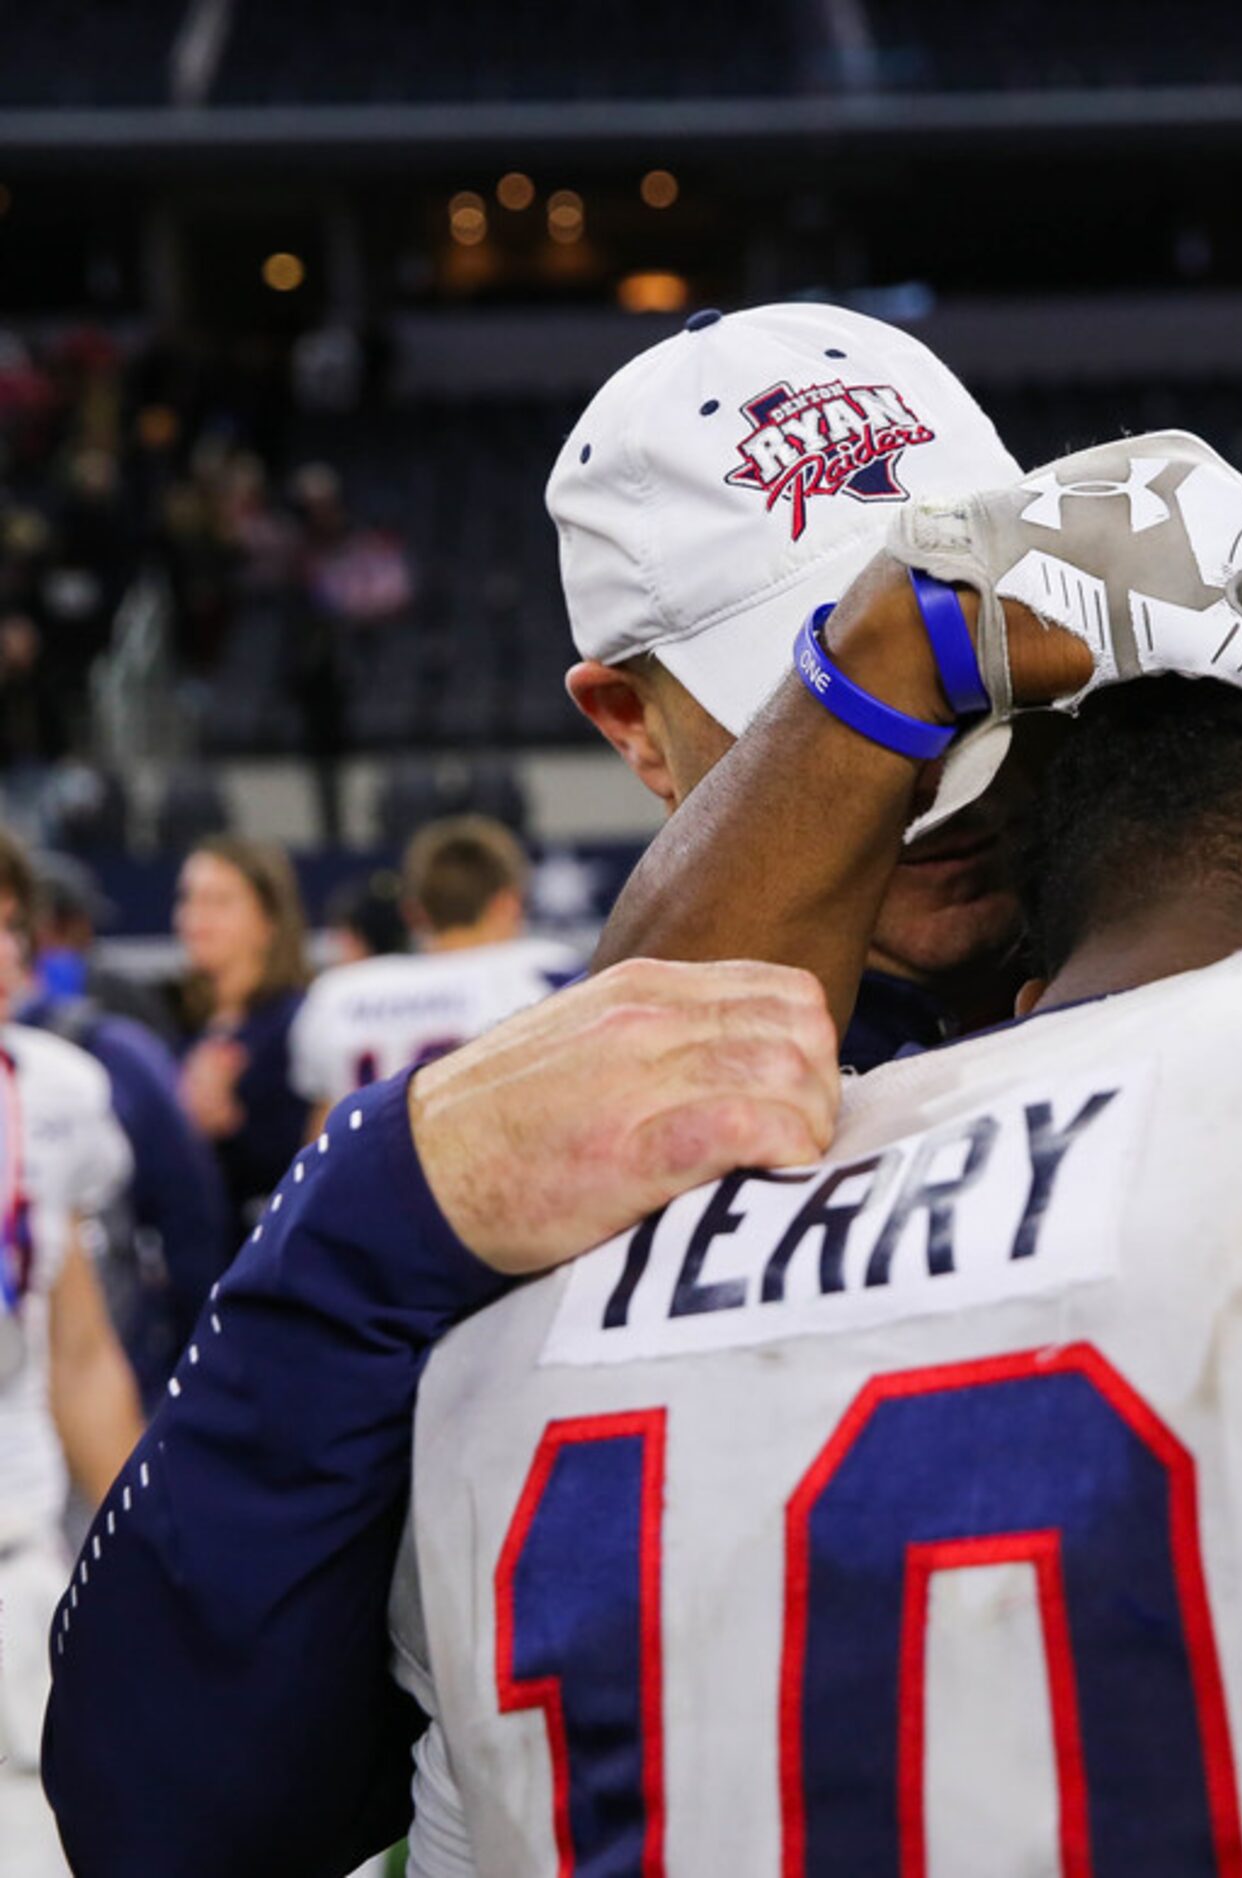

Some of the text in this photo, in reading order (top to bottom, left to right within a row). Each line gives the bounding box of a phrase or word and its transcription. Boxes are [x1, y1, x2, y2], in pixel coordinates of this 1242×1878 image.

[738, 386, 916, 488] RYAN
[766, 423, 936, 542] Raiders
[801, 649, 832, 694] ONE
